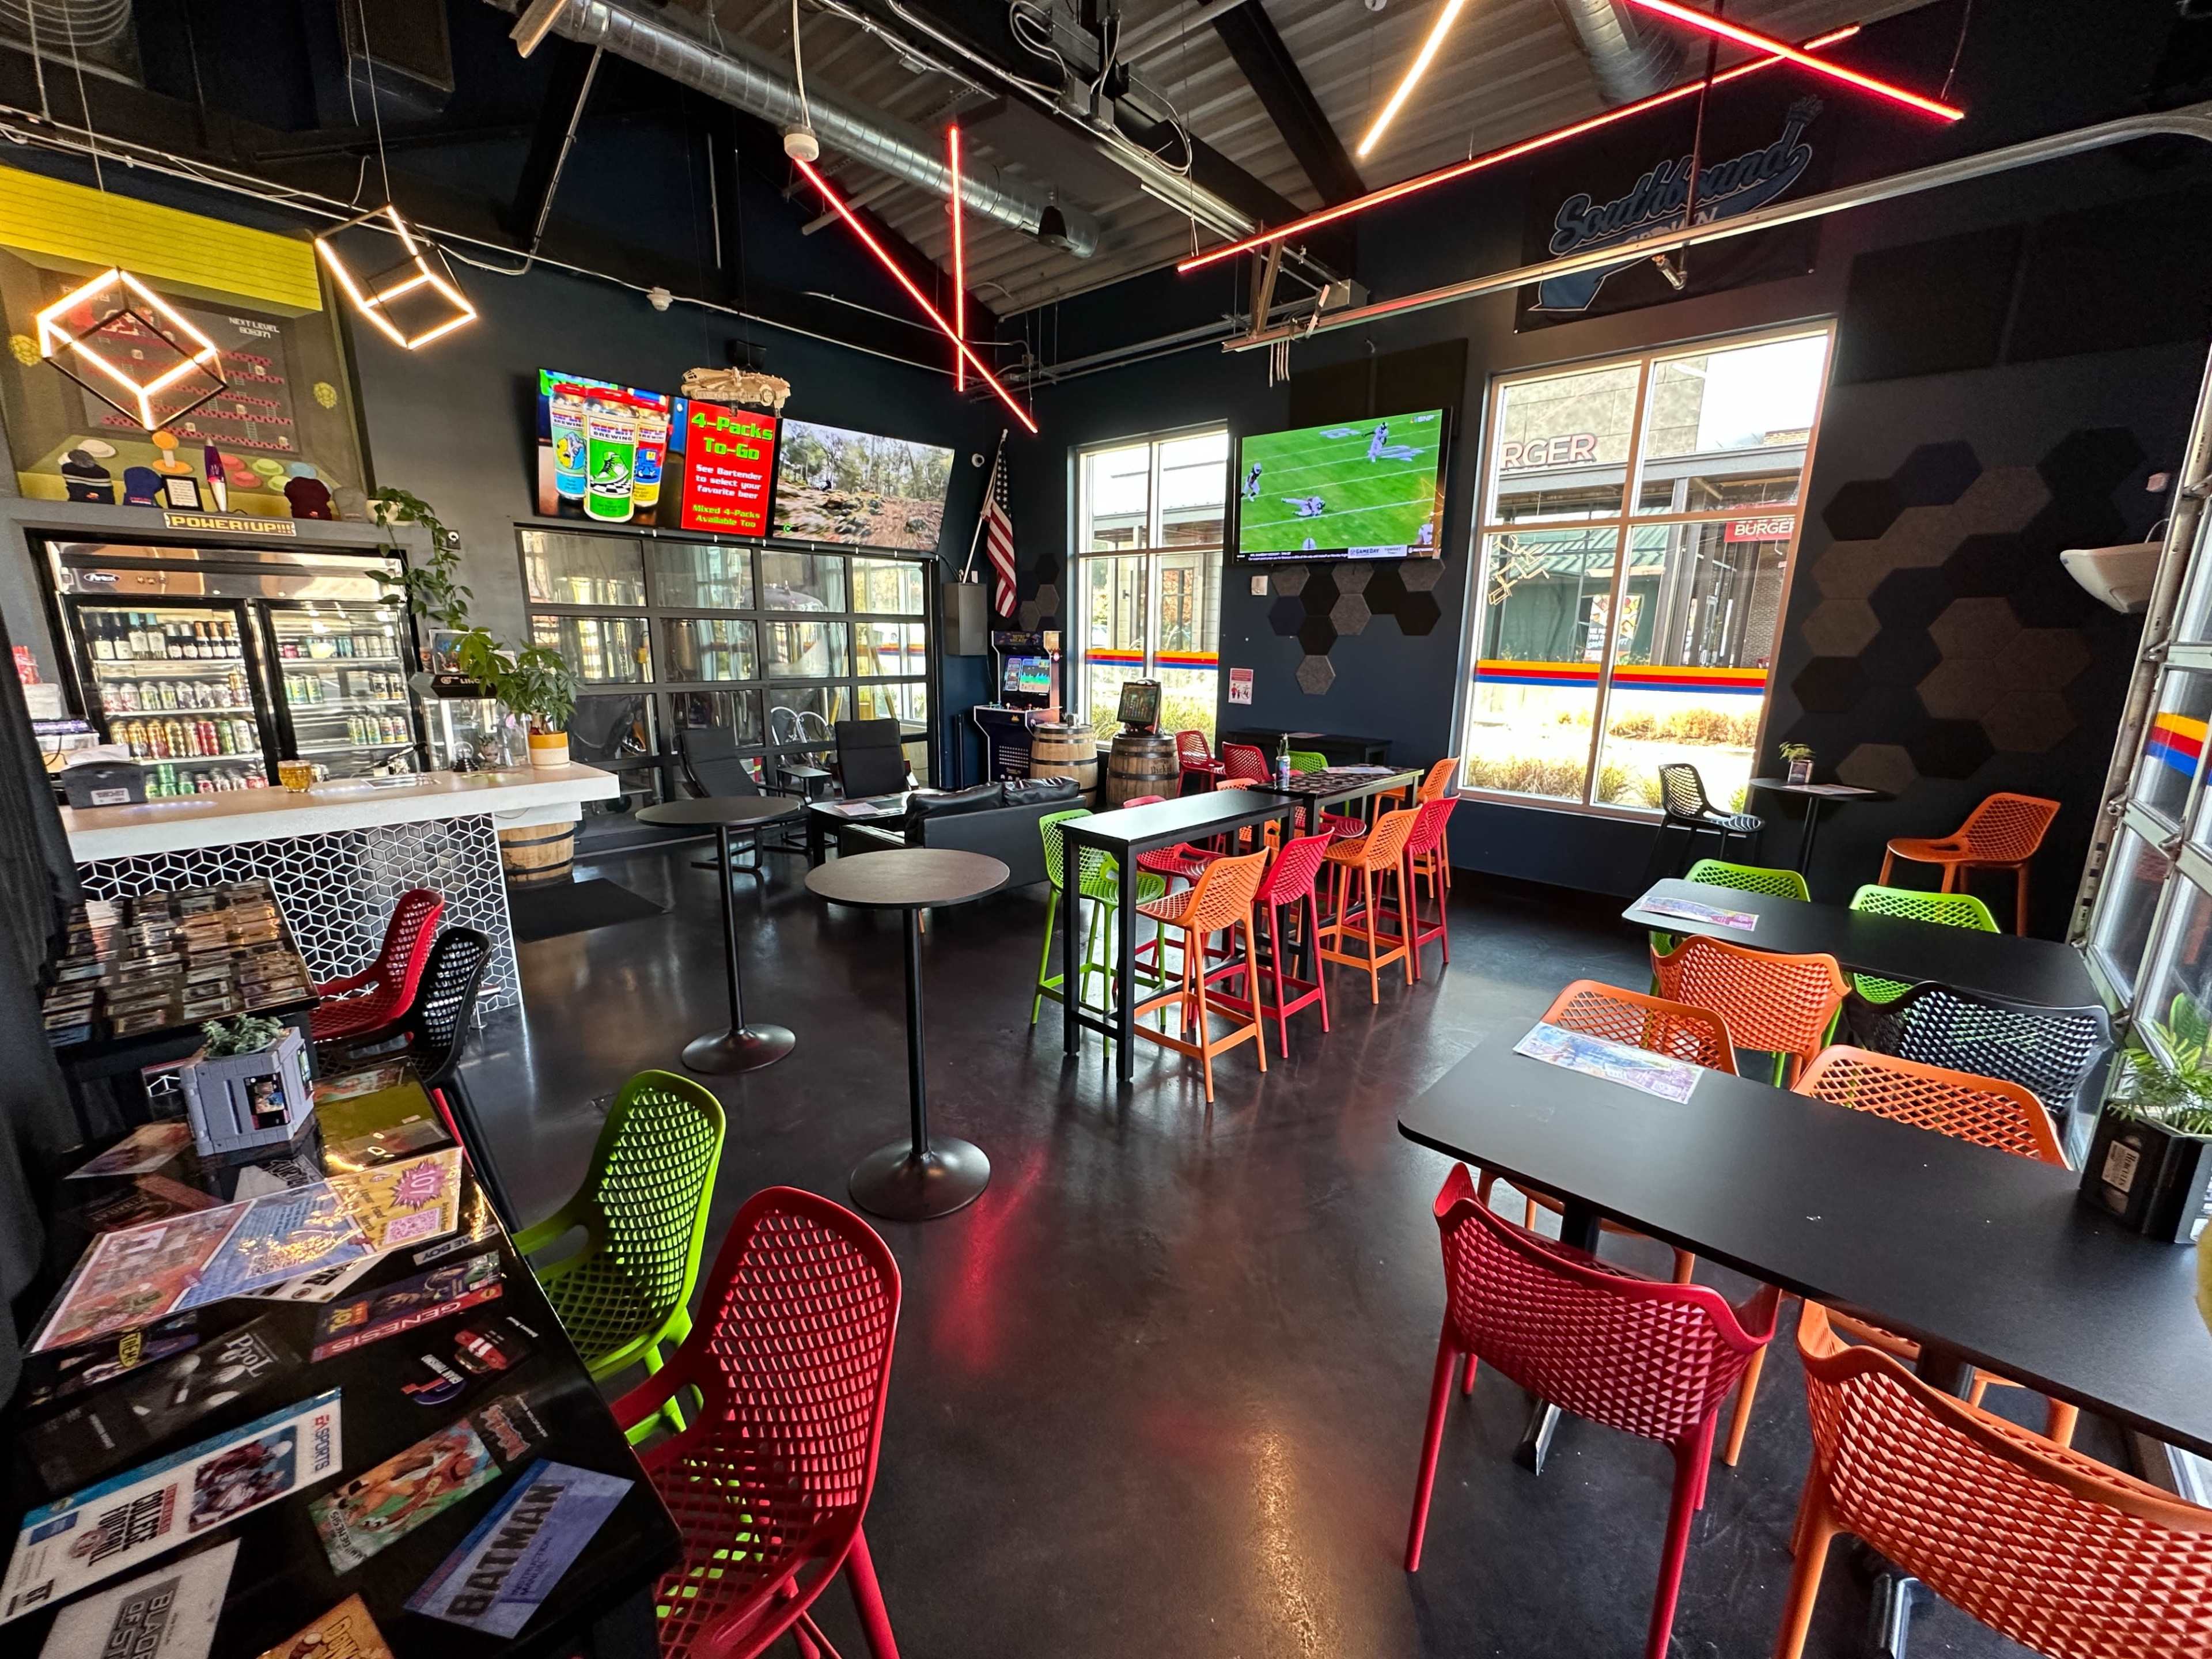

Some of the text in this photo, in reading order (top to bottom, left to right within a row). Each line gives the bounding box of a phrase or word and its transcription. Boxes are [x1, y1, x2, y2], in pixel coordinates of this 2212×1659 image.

[1550, 118, 1803, 255] Southbound
[229, 317, 281, 333] NEXT LEVEL
[593, 431, 633, 442] BREWING
[691, 412, 774, 441] 4-Packs
[703, 437, 760, 460] To-Go
[1501, 433, 1597, 469] RGER
[695, 464, 763, 481] See Bartender
[710, 476, 738, 487] select
[741, 482, 762, 490] your
[697, 485, 759, 499] favorite beer
[693, 504, 760, 519] Mixed 4-Packs
[696, 515, 756, 528] Available Too
[172, 516, 292, 535] POWER UP!!!
[409, 1169, 437, 1194] 107
[423, 1224, 497, 1261] GME BOY
[331, 1301, 462, 1354] GENESIS
[315, 1427, 331, 1472] SPORTS
[122, 1489, 165, 1551] COLLEGE
[88, 1502, 131, 1567] FOOTBALL
[446, 1484, 567, 1618] BATMAN
